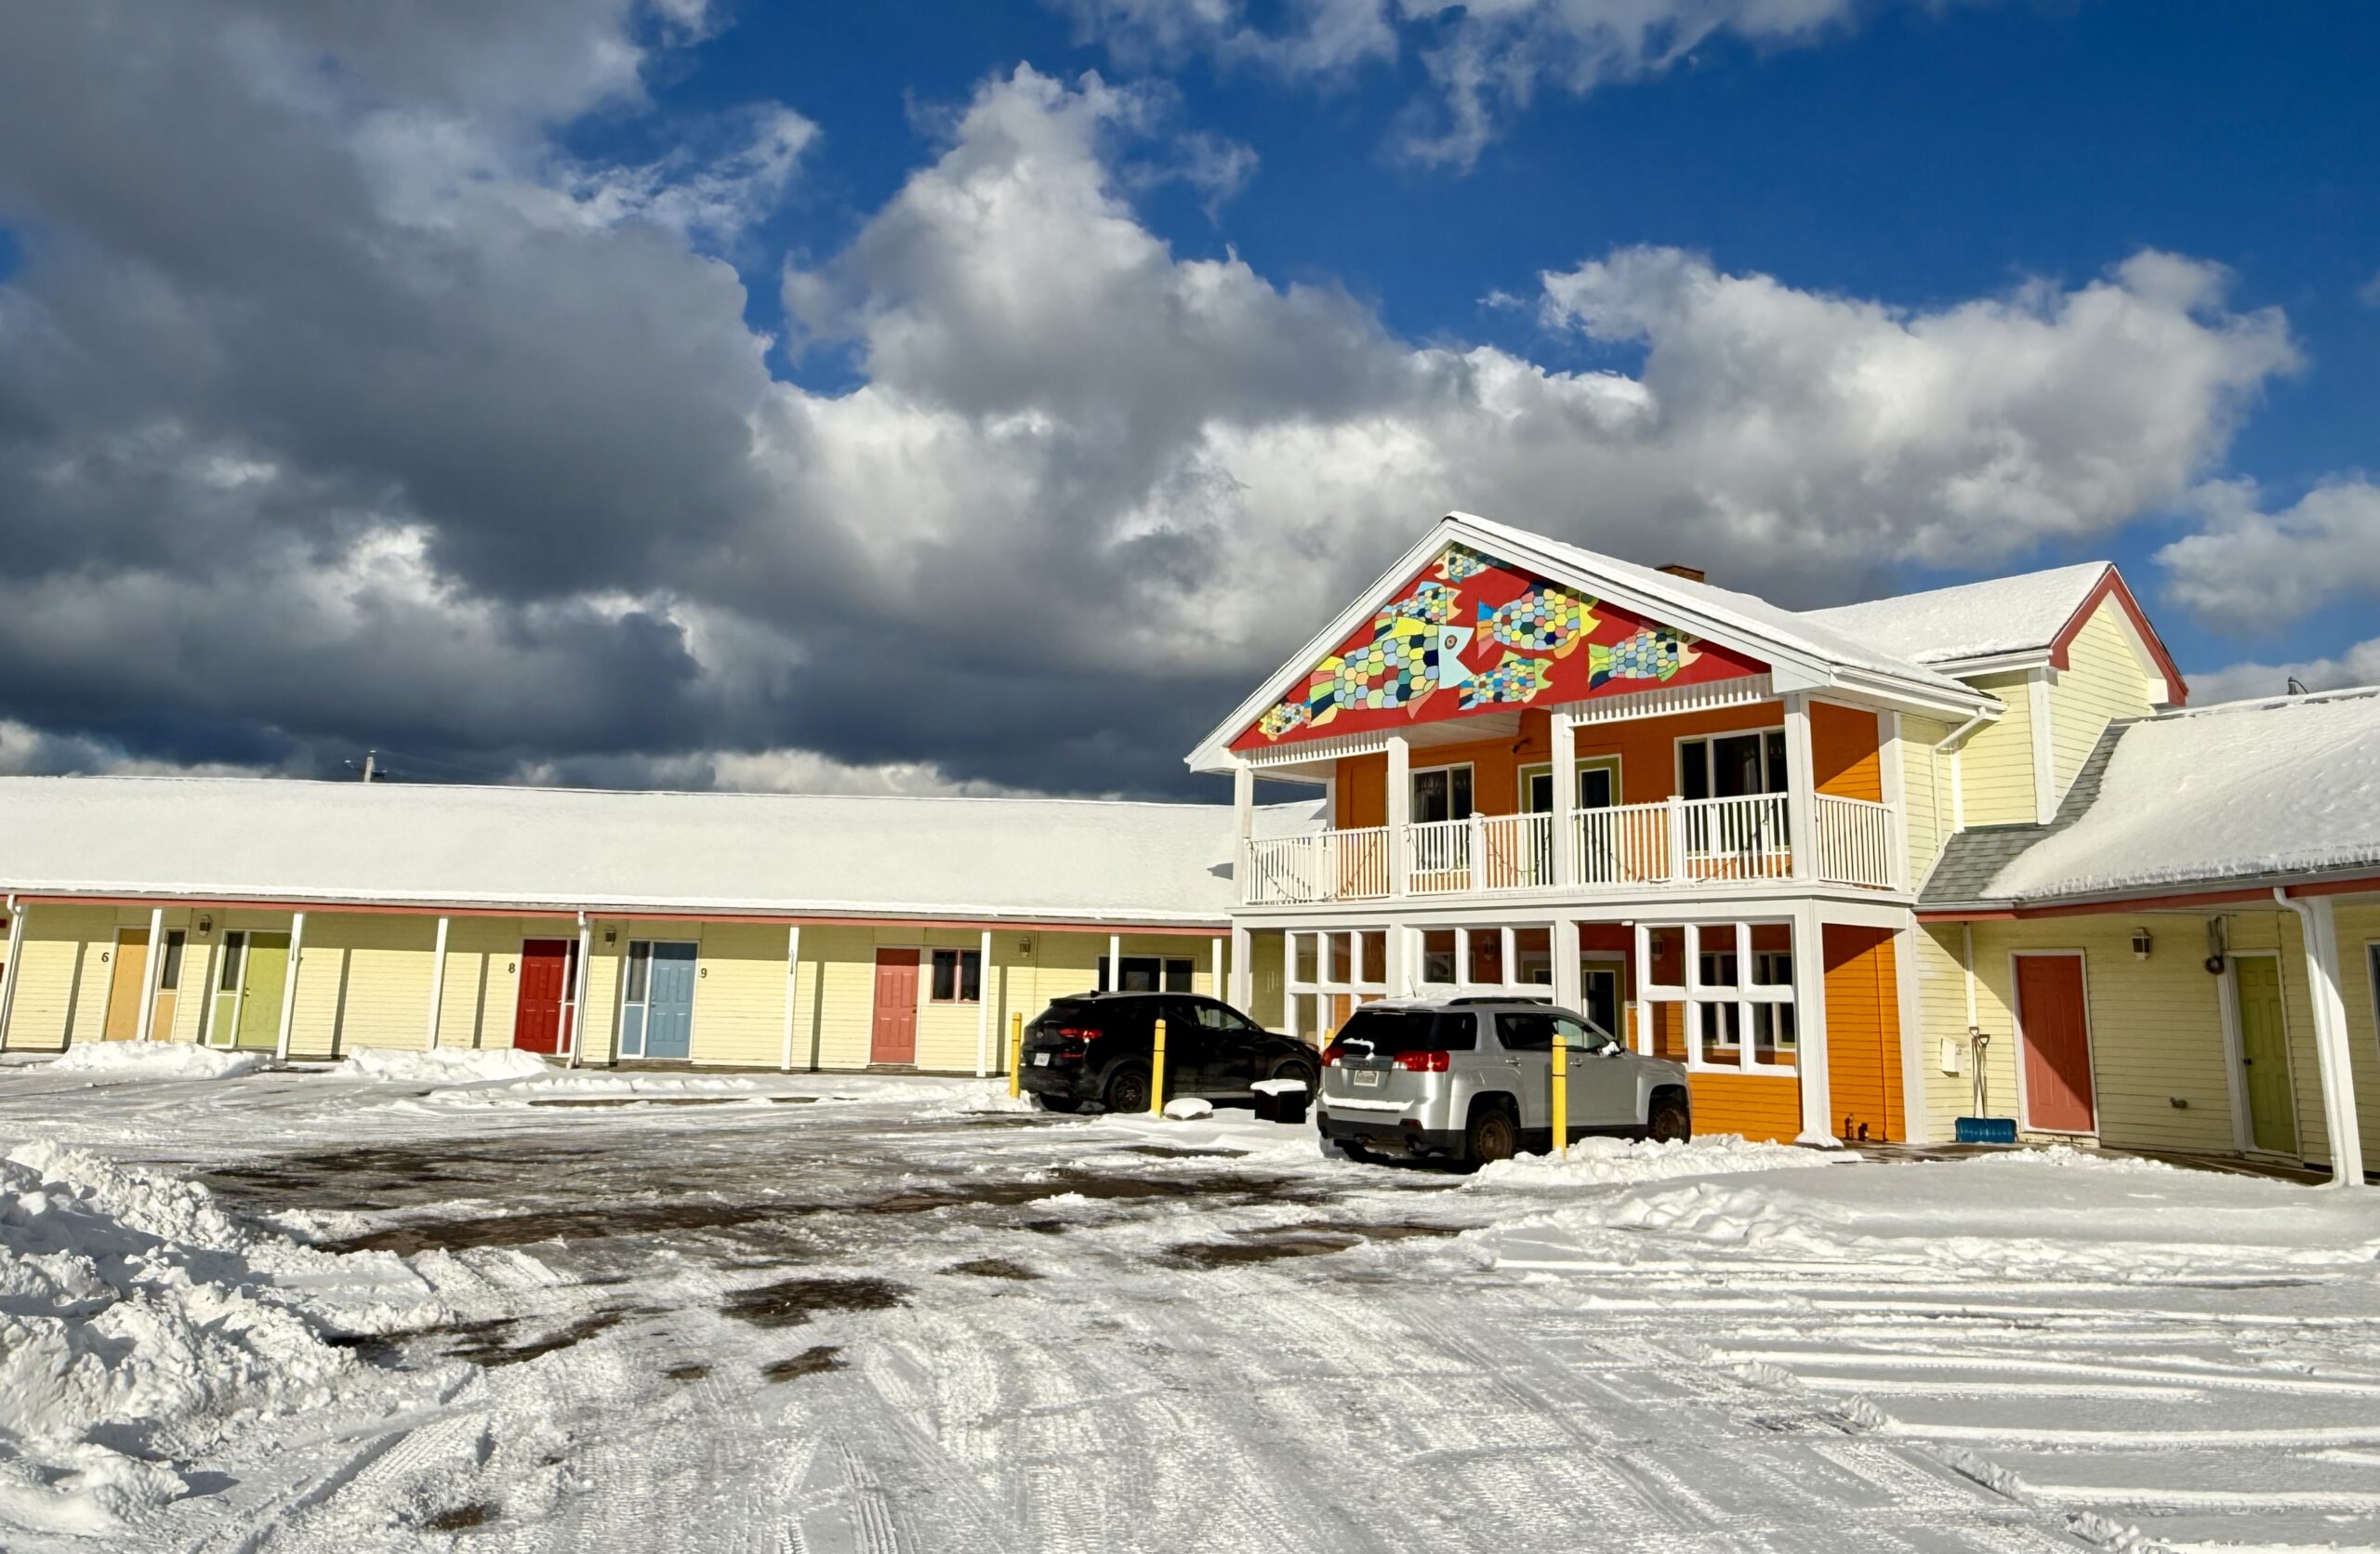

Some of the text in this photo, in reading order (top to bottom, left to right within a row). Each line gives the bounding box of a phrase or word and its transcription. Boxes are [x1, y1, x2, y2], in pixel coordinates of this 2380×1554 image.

[101, 952, 110, 963] 6
[509, 962, 516, 974] 8
[700, 968, 707, 979] 9
